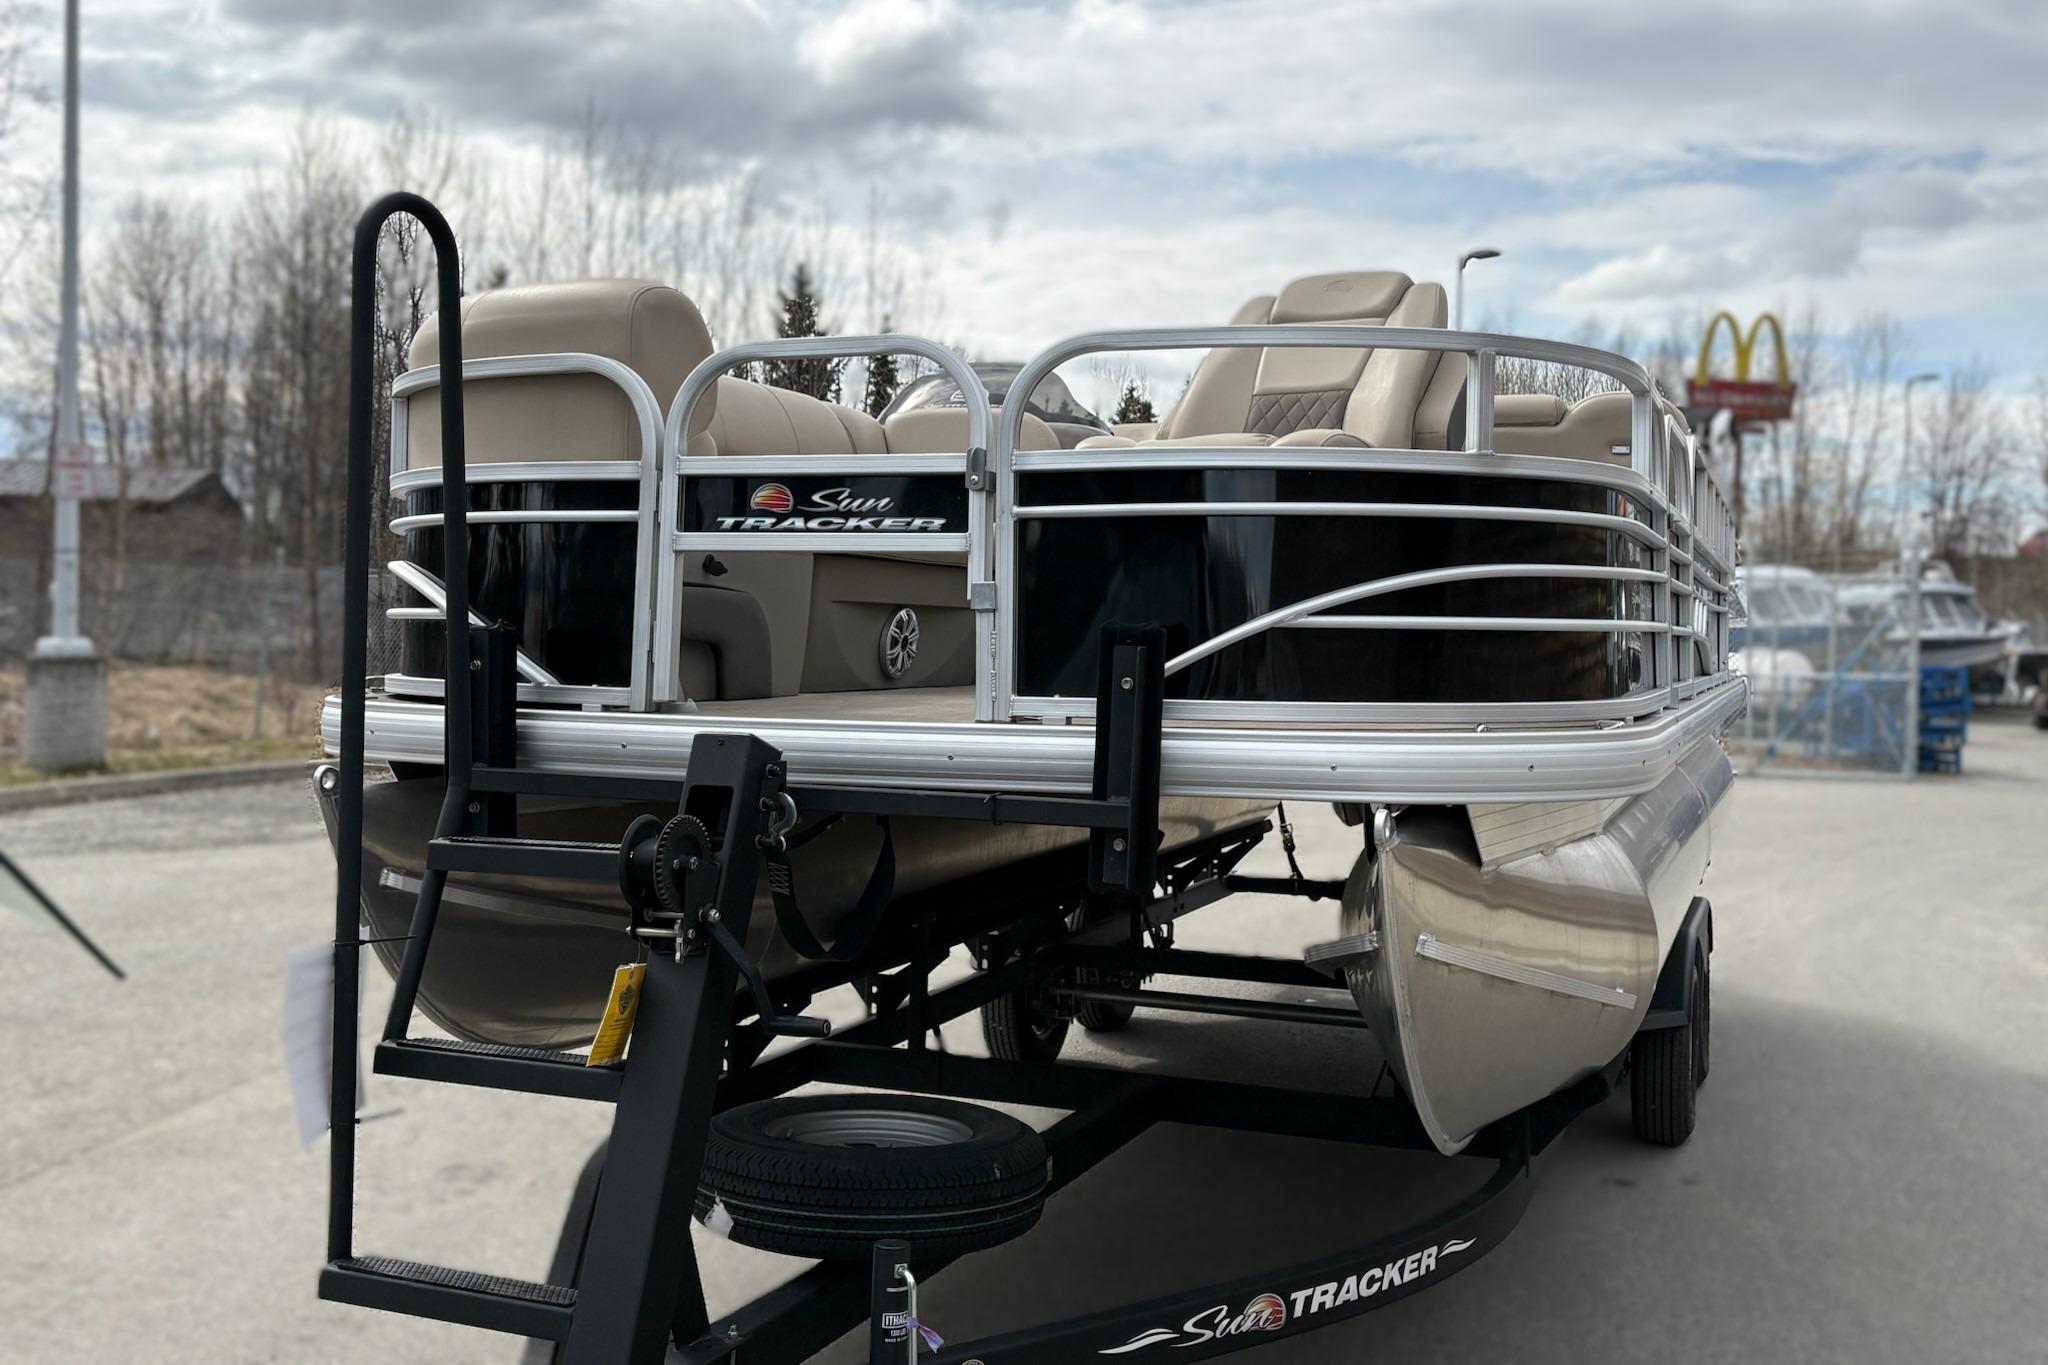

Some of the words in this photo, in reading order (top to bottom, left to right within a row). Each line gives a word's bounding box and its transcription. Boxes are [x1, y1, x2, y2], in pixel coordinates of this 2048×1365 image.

[797, 487, 895, 513] Sun
[716, 516, 947, 532] TRACKER
[1169, 1304, 1284, 1348] Sun
[1289, 1245, 1438, 1320] TRACKER
